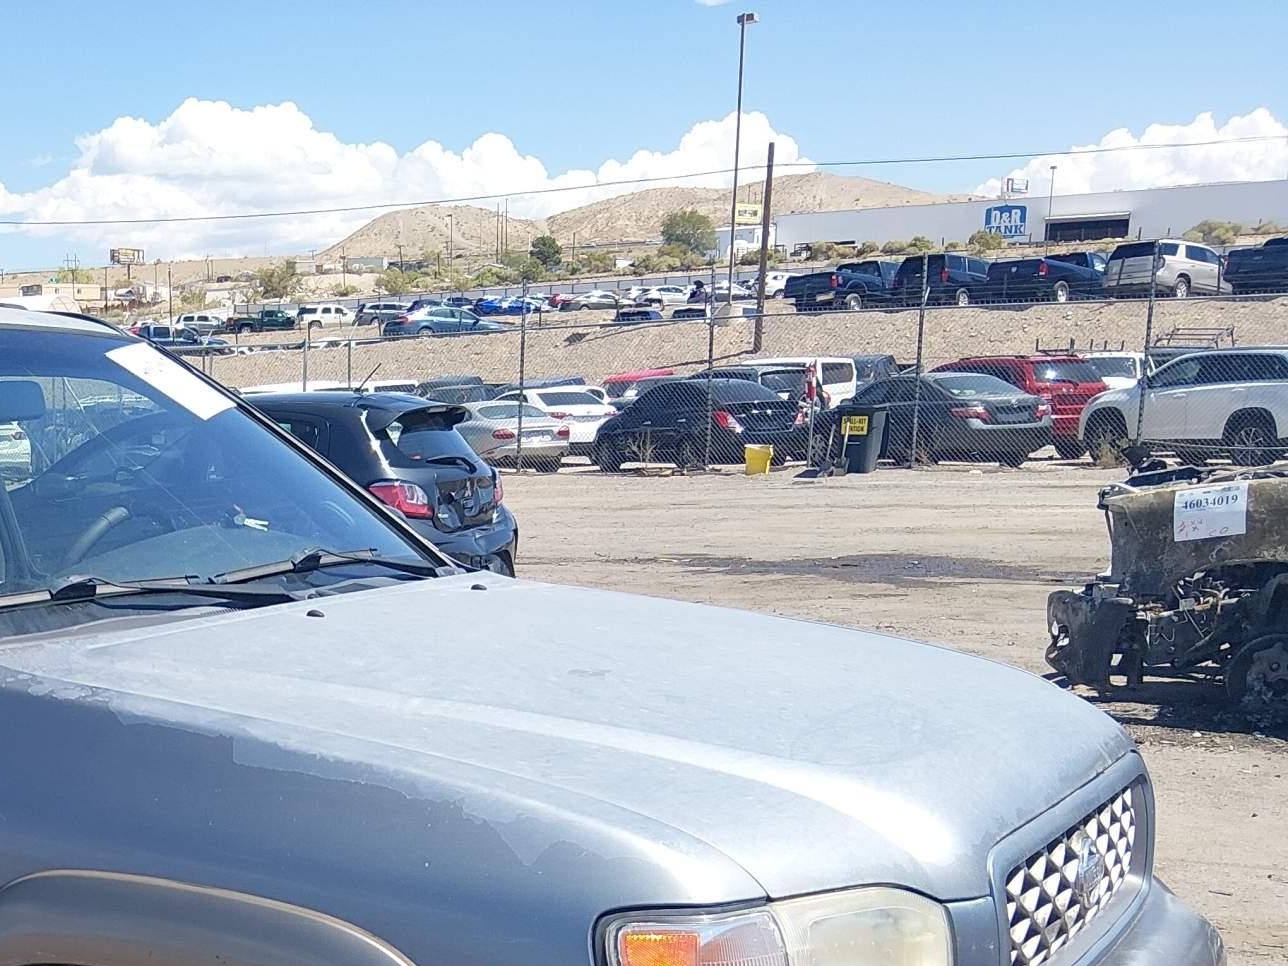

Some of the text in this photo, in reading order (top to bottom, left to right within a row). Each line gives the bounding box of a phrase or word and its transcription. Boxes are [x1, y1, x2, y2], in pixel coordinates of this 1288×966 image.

[991, 209, 1022, 225] D&R
[986, 224, 1023, 234] TANK
[1182, 494, 1239, 510] 46034019
